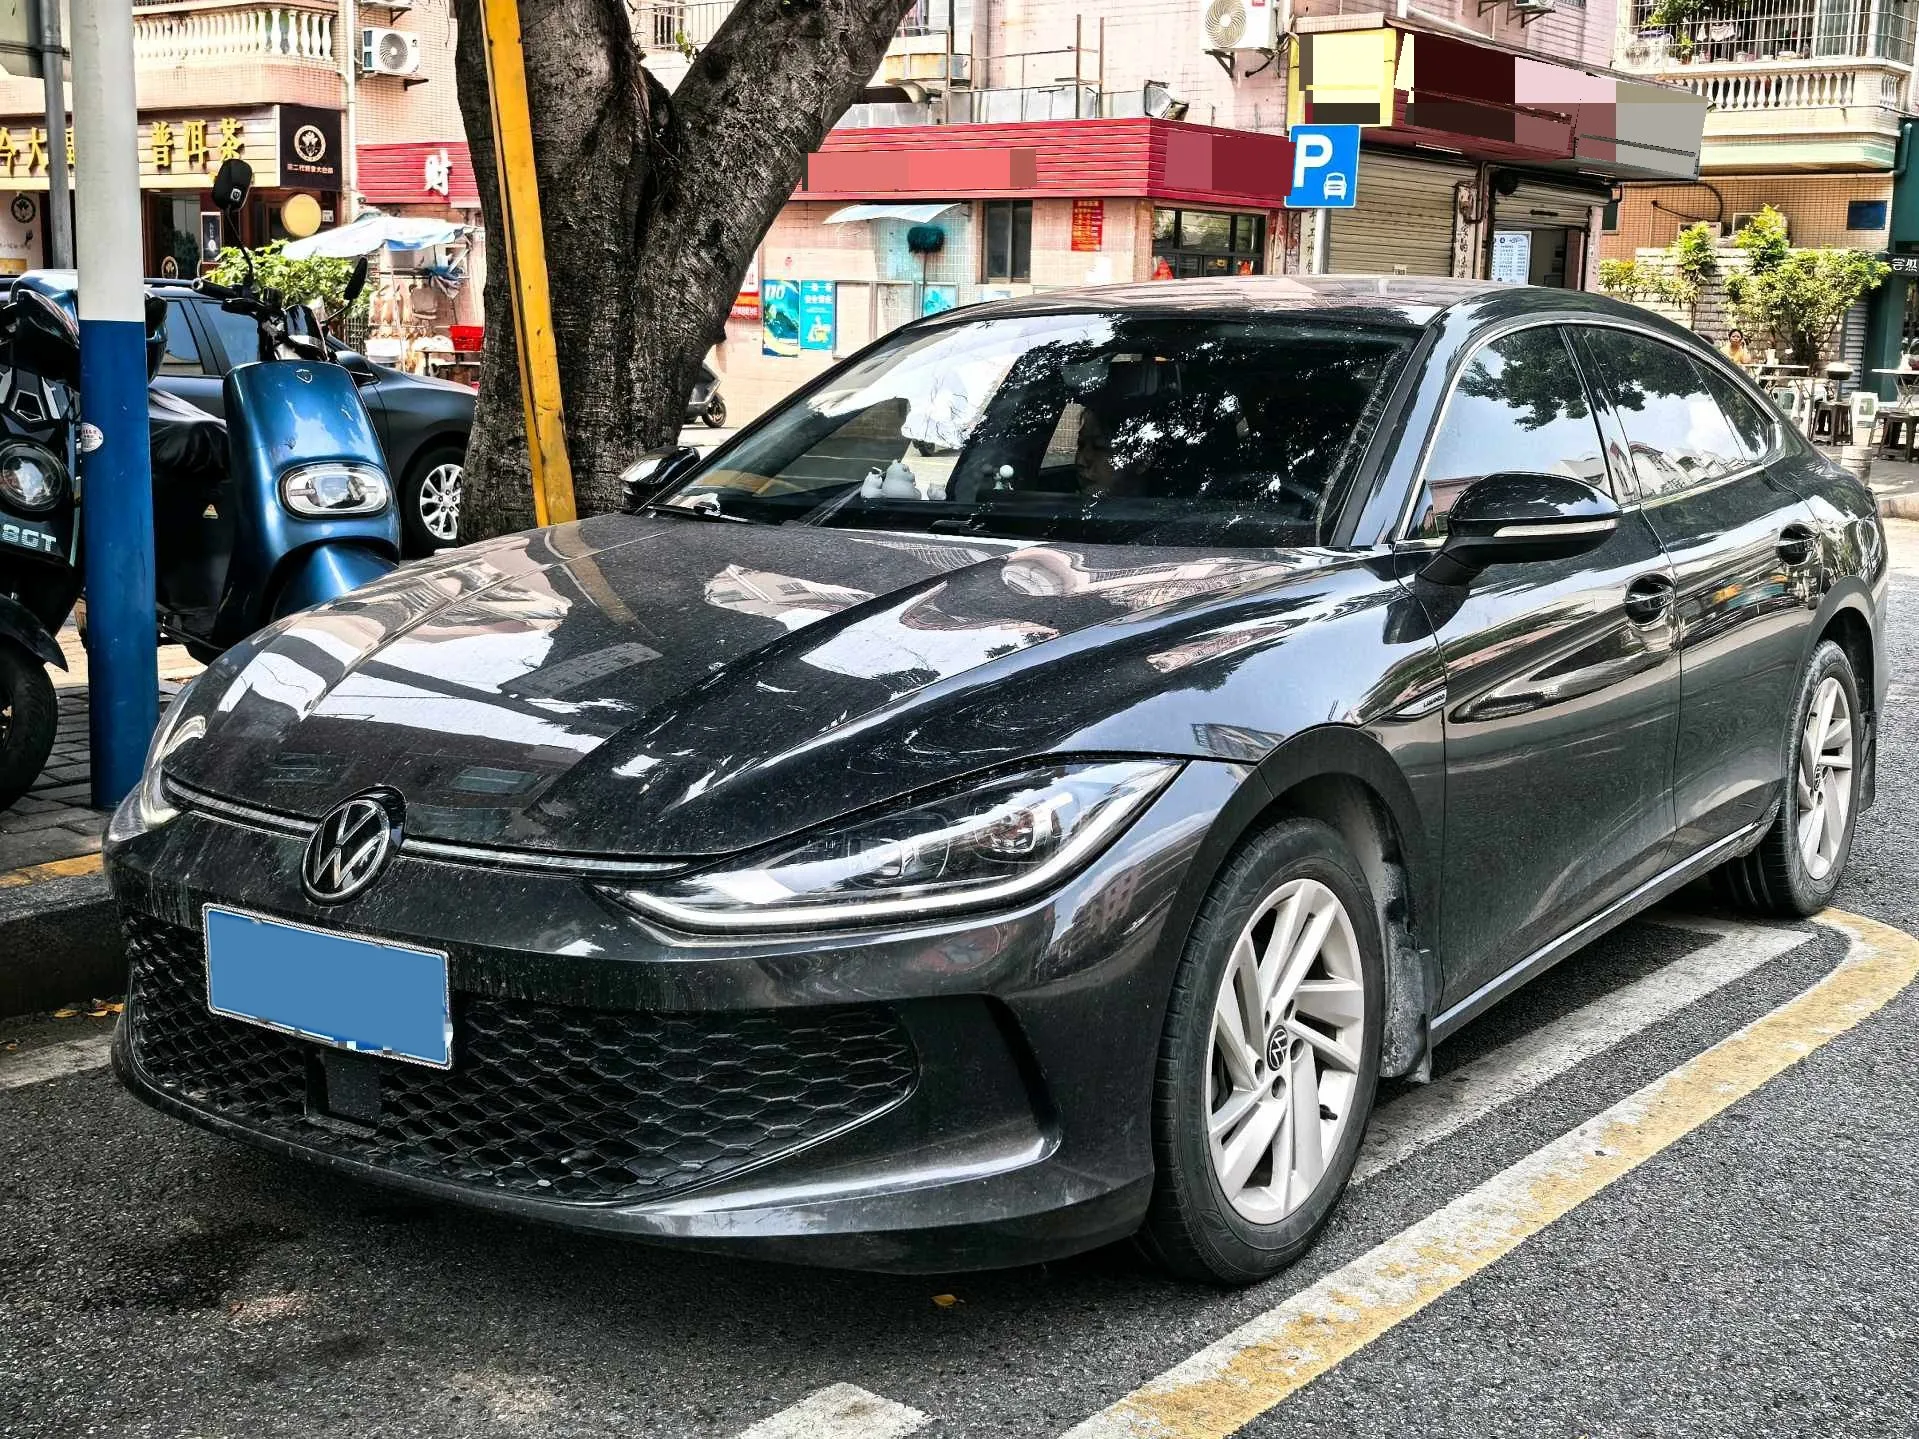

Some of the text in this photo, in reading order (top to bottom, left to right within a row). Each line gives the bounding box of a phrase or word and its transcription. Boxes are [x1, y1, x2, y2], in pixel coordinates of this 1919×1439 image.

[151, 117, 242, 167] 普洱茶
[1293, 134, 1333, 188] P
[424, 148, 452, 196] 财
